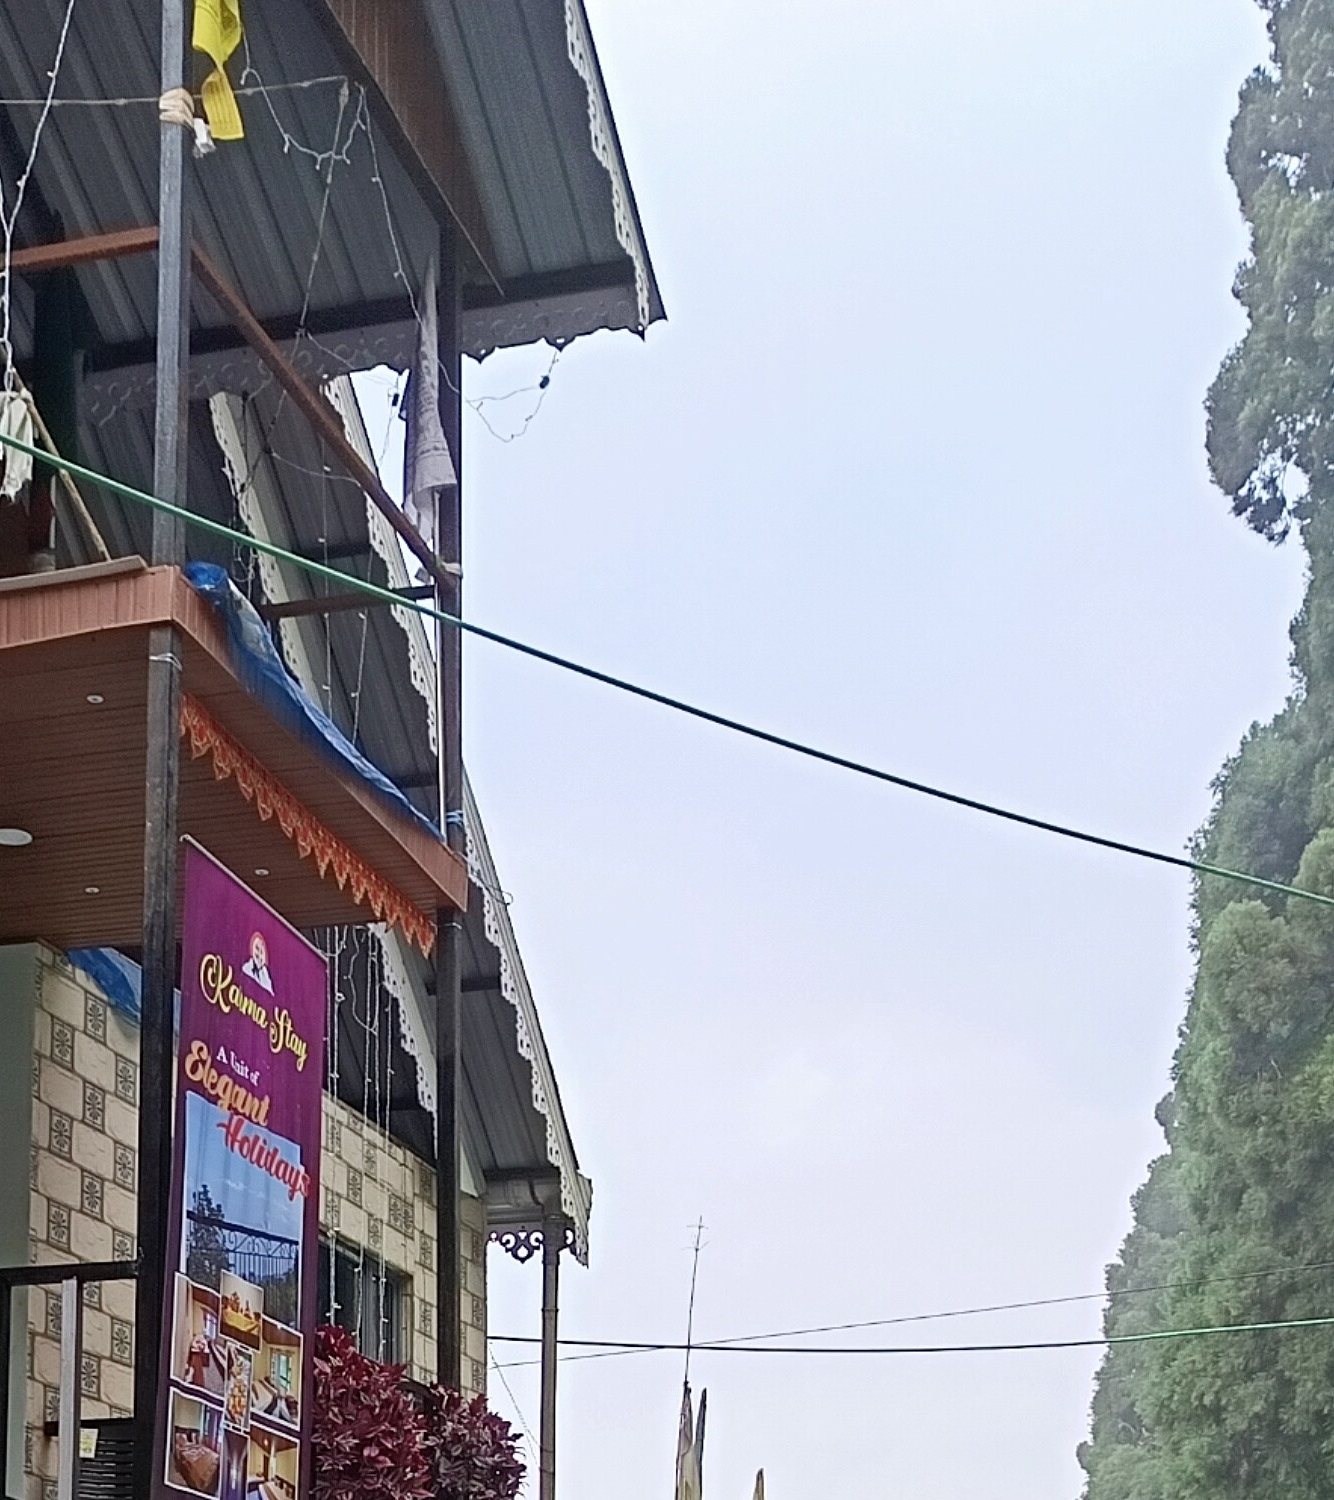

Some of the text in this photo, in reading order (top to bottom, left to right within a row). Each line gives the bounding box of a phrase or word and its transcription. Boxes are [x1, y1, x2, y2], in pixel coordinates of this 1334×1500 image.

[200, 954, 307, 1072] Karma Stay
[185, 1040, 270, 1126] Elegant
[216, 1046, 260, 1086] A Unit of
[217, 1113, 311, 1201] Holidays
